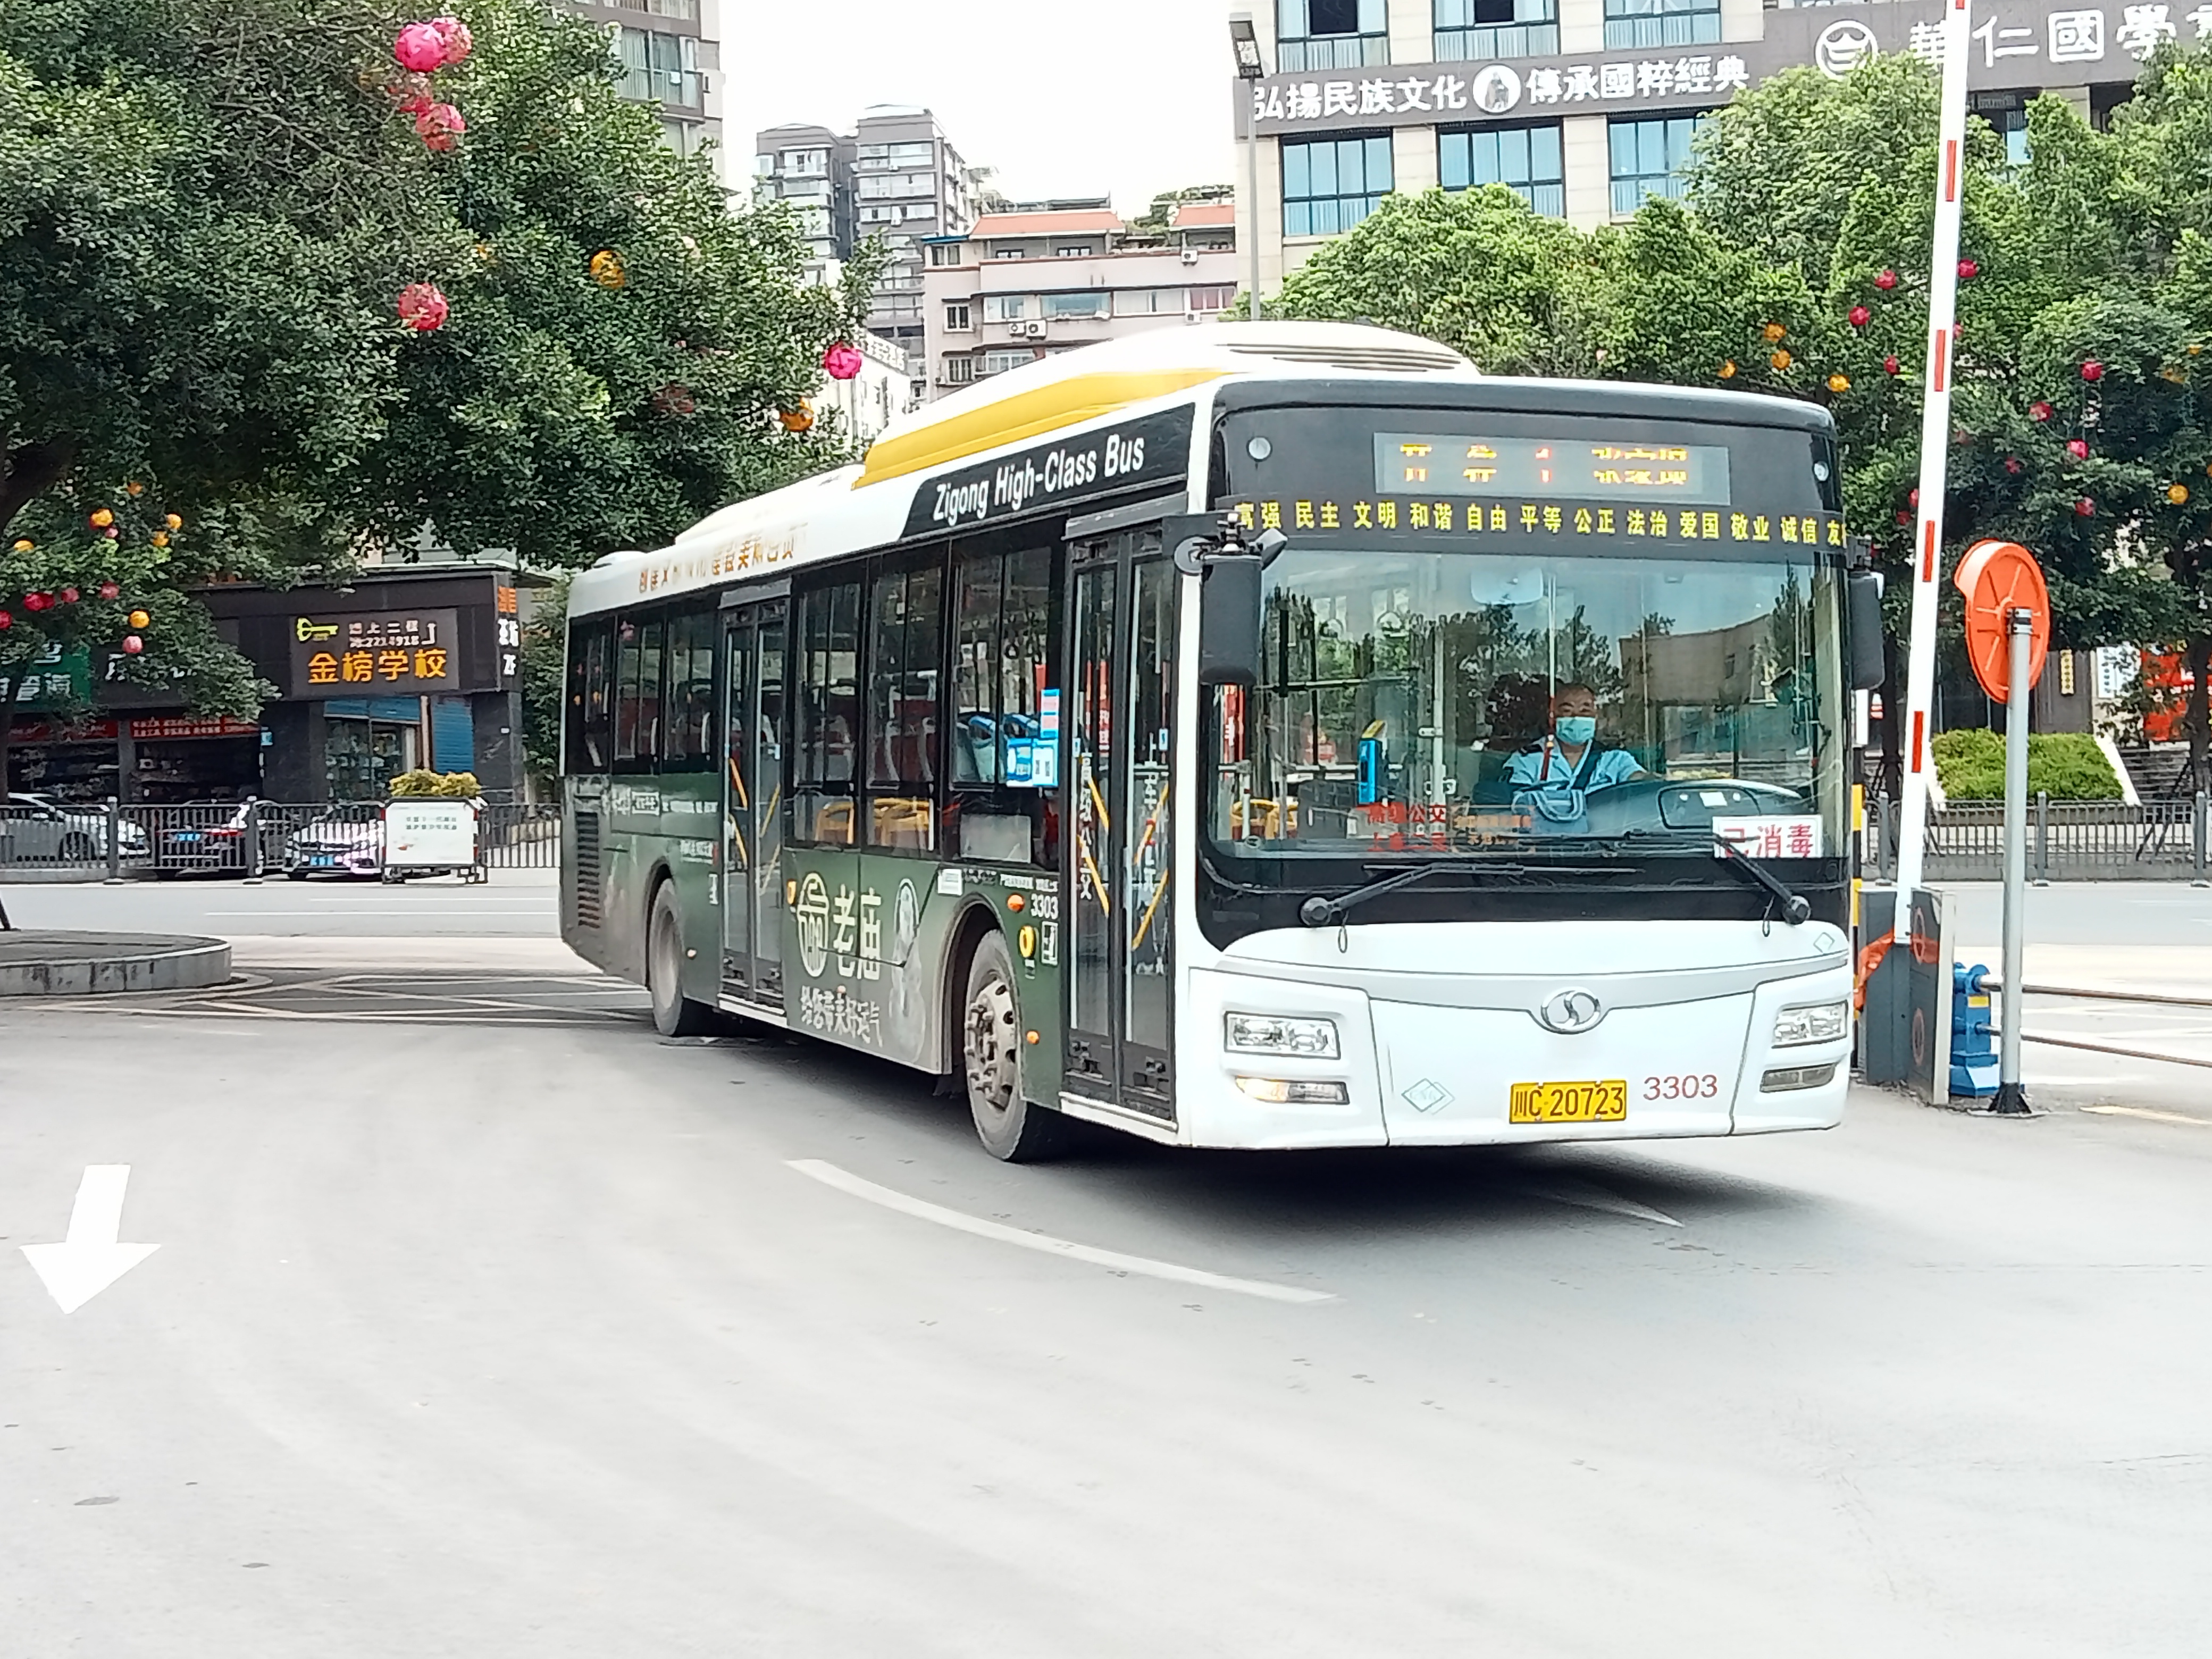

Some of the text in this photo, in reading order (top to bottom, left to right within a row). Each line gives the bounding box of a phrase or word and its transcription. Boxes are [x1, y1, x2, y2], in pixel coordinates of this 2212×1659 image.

[1254, 54, 1750, 121] 弘揚民族文化 傳承國粹經典
[933, 433, 1145, 526] Zigong High-Class Bus
[1234, 501, 1847, 548] 富强 民主 文明 和谐 自由 平等 公正 法治 爱国 敬业 诚信 友
[308, 648, 448, 684] 金榜学校
[1030, 893, 1059, 920] 3303
[833, 883, 882, 980] 老庙
[1643, 1074, 1718, 1101] 3303
